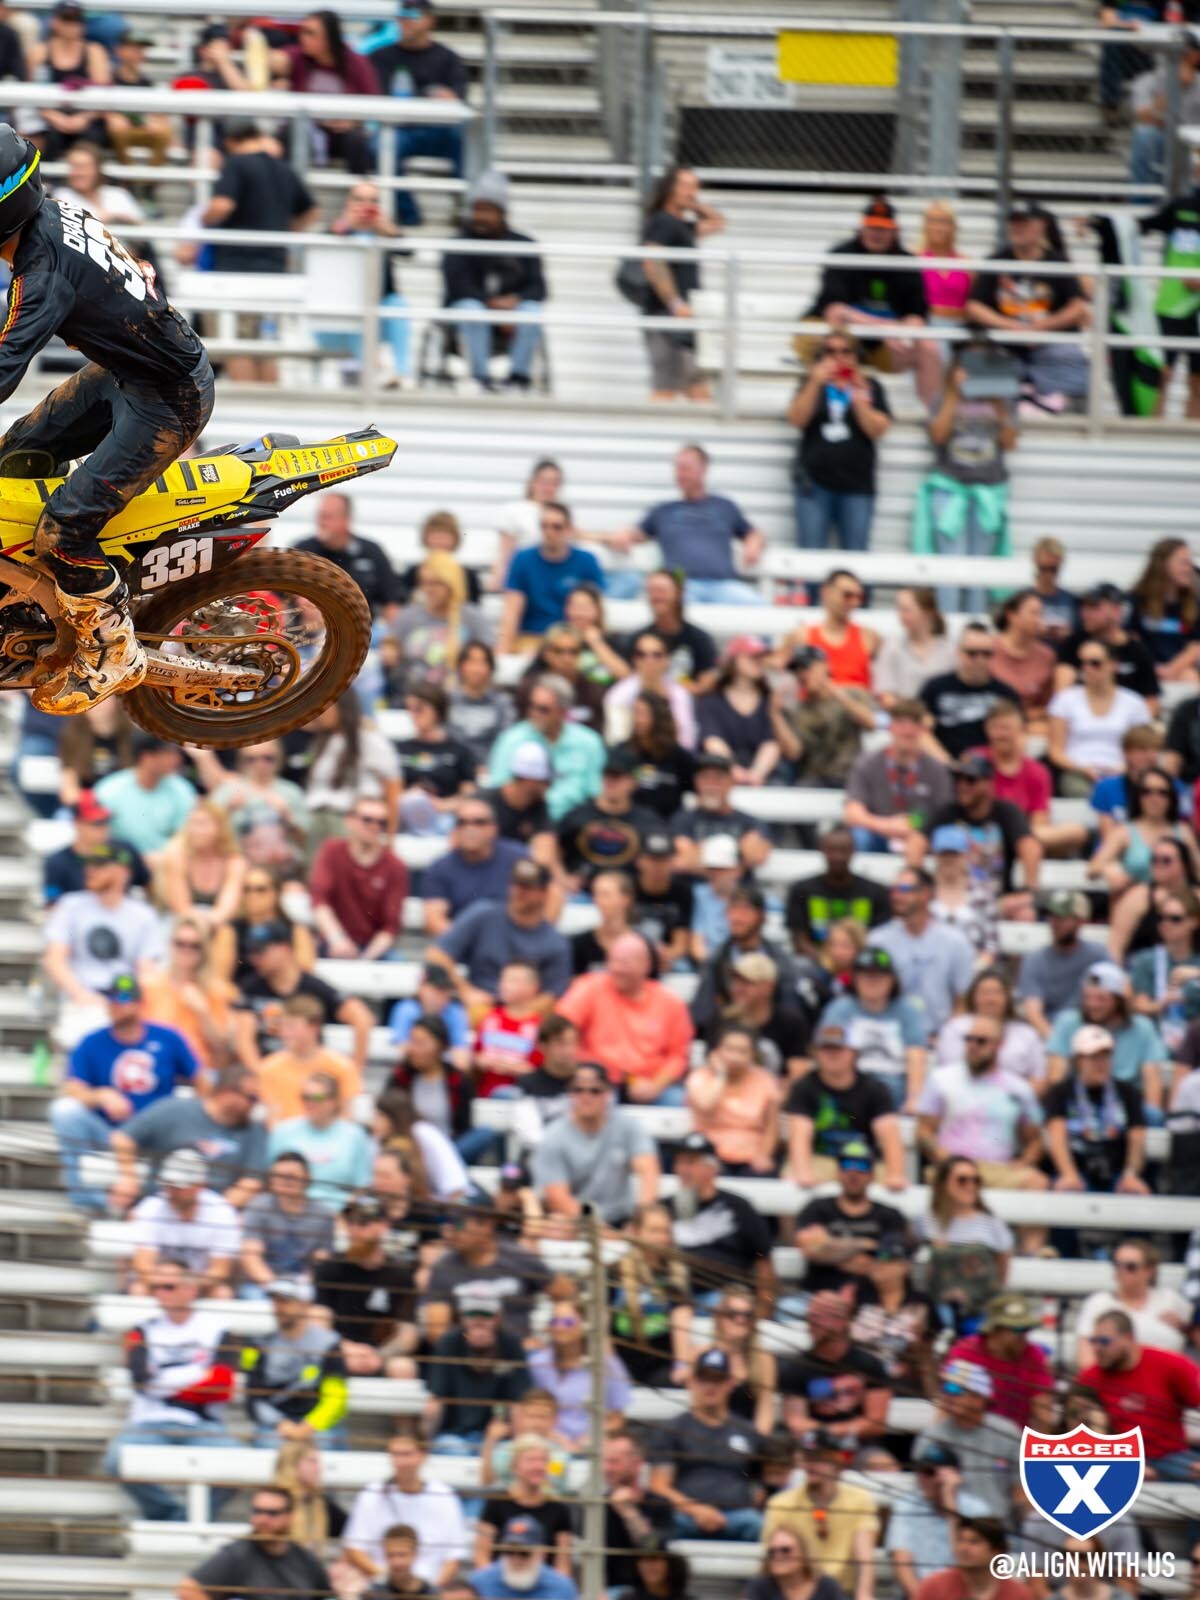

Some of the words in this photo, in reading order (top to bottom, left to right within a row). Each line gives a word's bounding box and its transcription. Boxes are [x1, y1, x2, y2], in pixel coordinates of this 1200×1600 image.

[320, 465, 356, 483] PIRELLI
[273, 482, 309, 499] FuelMe
[178, 521, 200, 533] DRAKE
[141, 538, 214, 590] 331
